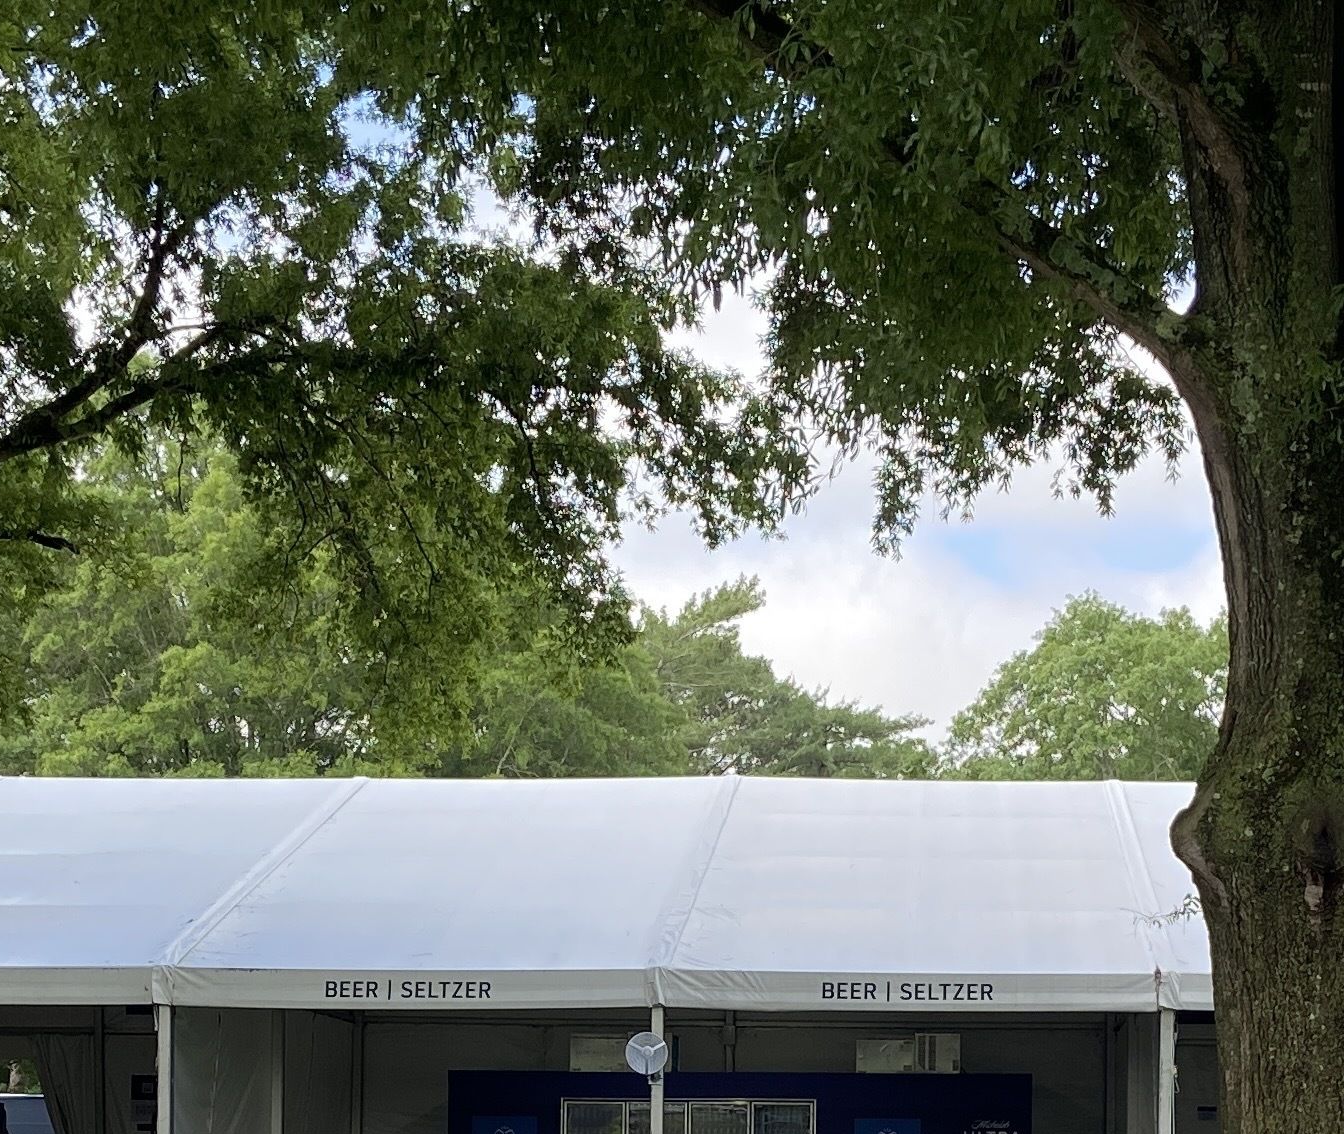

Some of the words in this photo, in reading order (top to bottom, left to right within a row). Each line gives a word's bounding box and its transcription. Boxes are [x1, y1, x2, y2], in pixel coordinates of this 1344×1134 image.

[325, 981, 378, 998] BEER
[401, 981, 491, 998] SELTZER
[822, 982, 877, 999] BEER
[900, 982, 994, 1000] SELTZER
